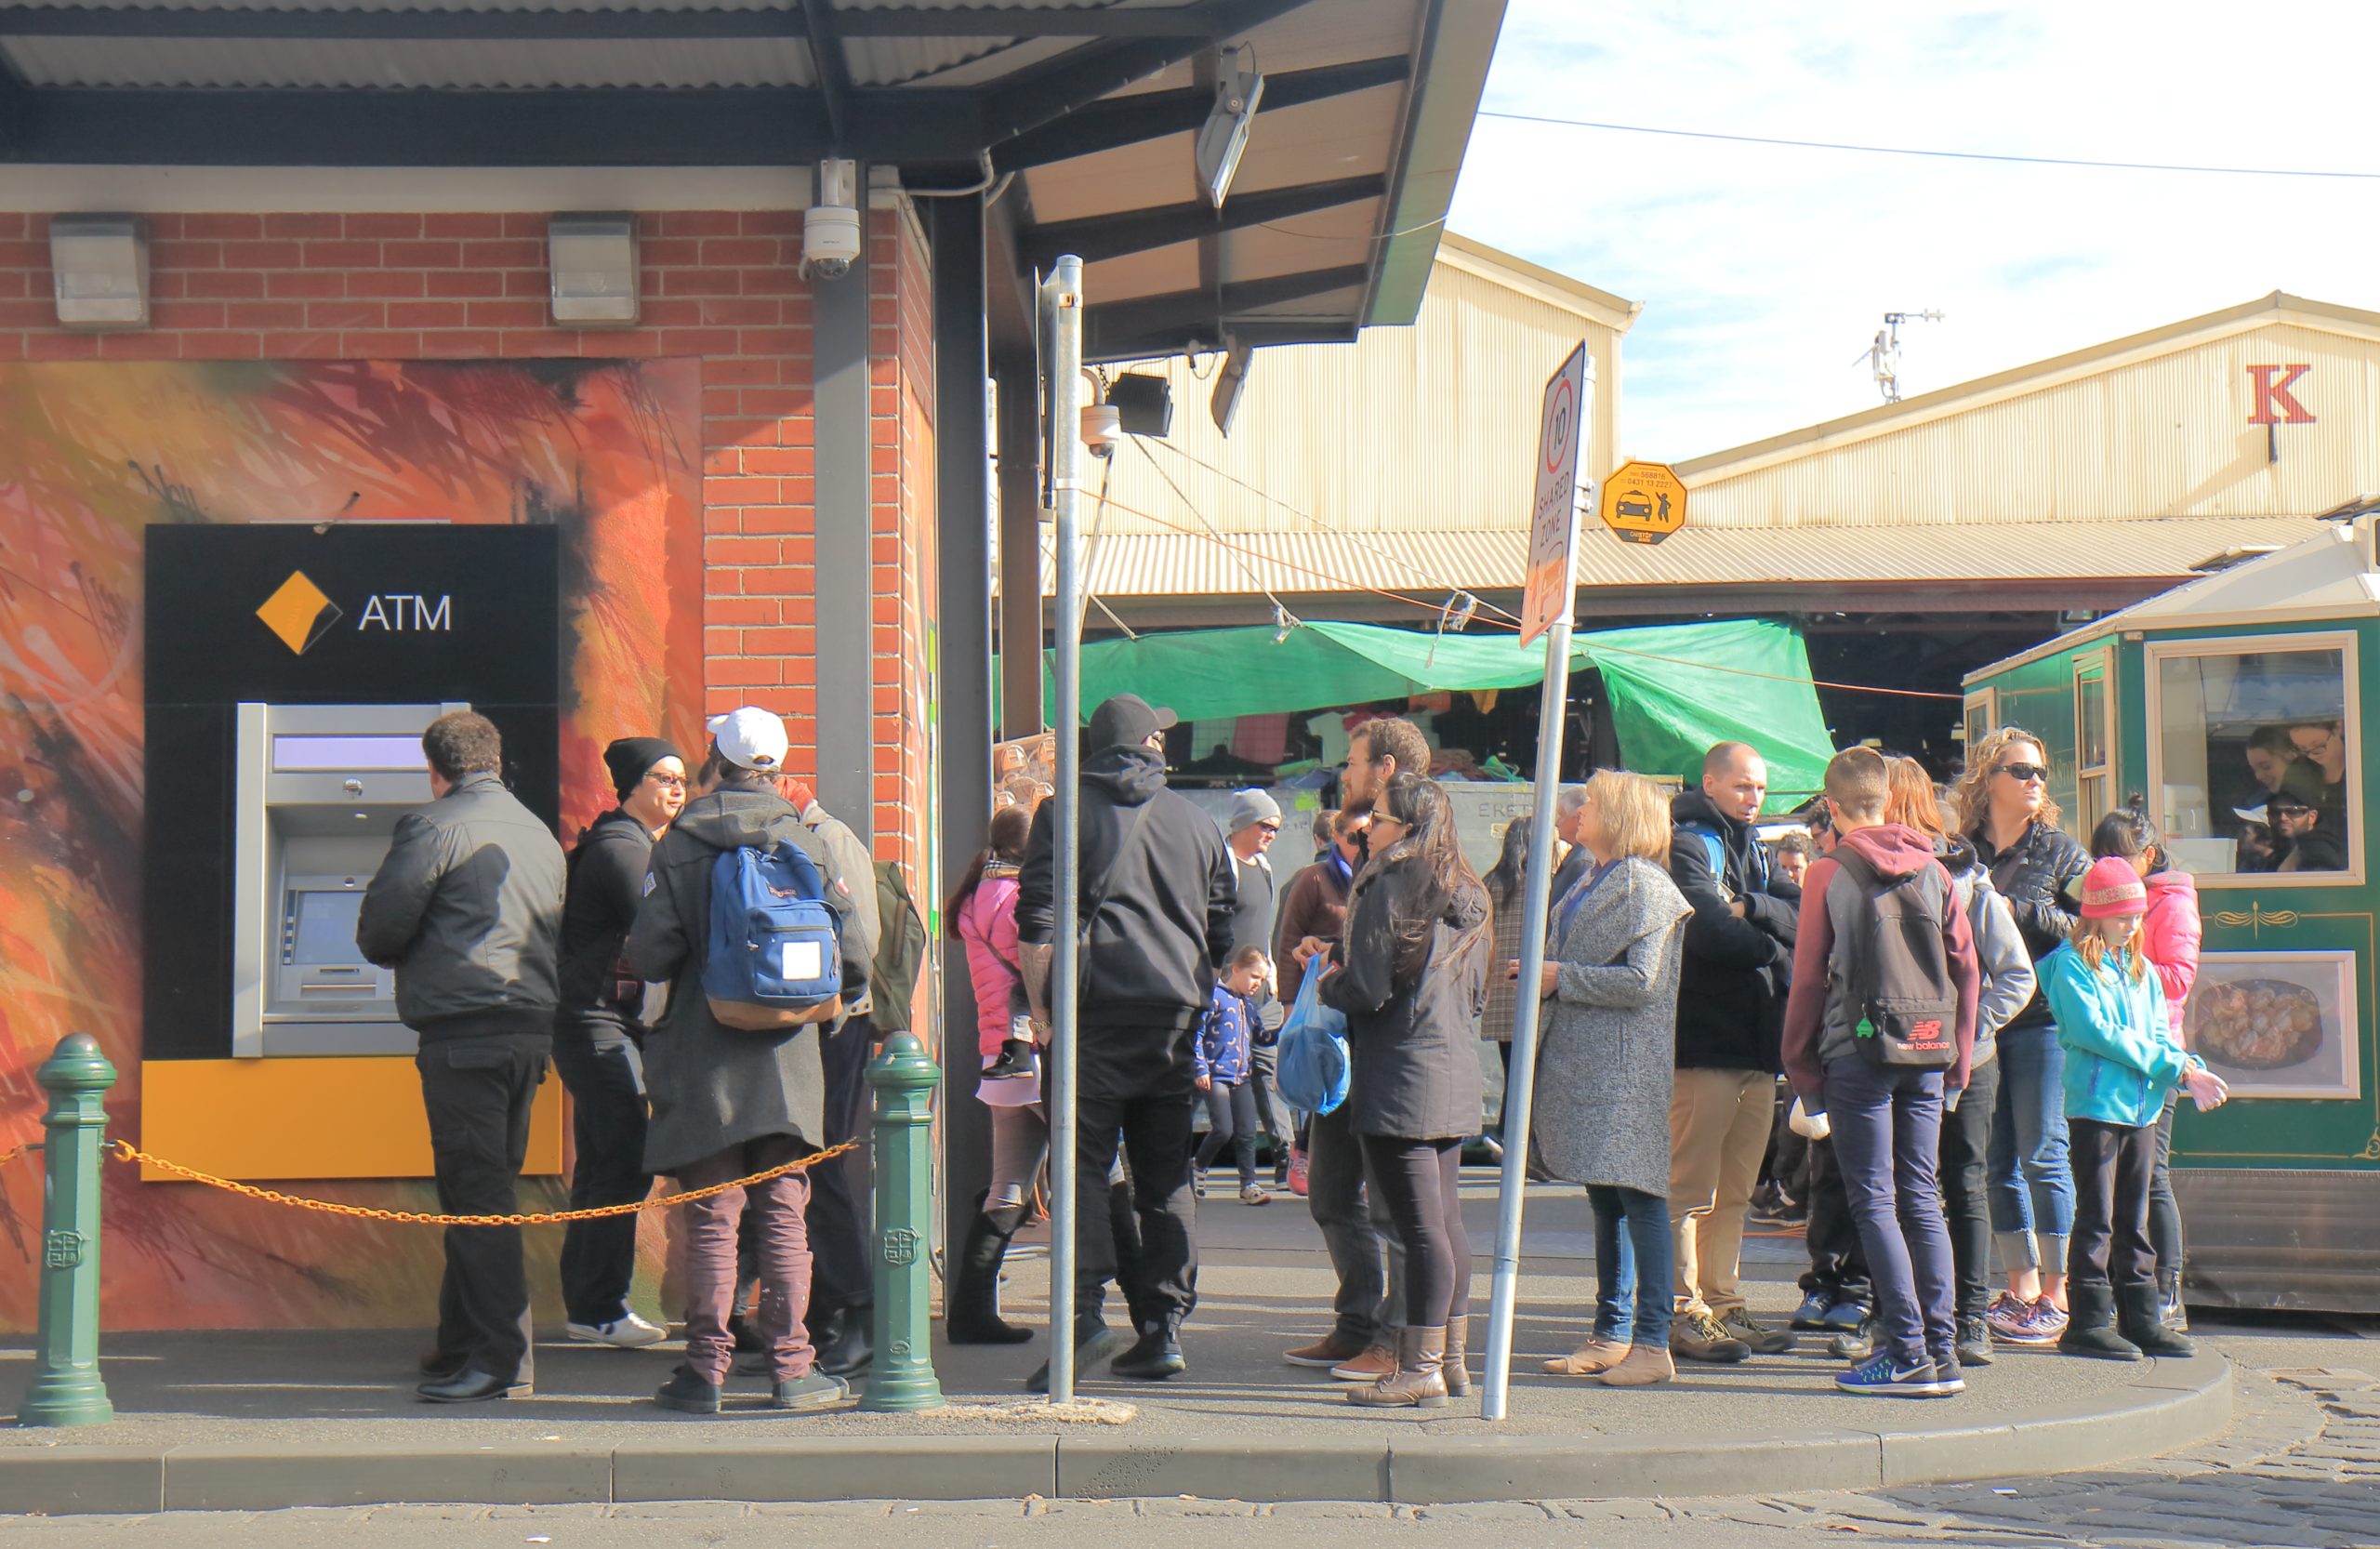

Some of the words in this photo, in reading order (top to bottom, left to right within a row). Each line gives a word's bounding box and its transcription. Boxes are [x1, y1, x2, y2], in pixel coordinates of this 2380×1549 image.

[2246, 364, 2316, 424] K
[1554, 407, 1566, 449] 10
[1539, 471, 1569, 520] SHARED
[1628, 478, 1644, 486] 0431
[1540, 509, 1562, 548] ZONE
[358, 595, 451, 630] ATM
[1897, 1042, 1914, 1051] new
